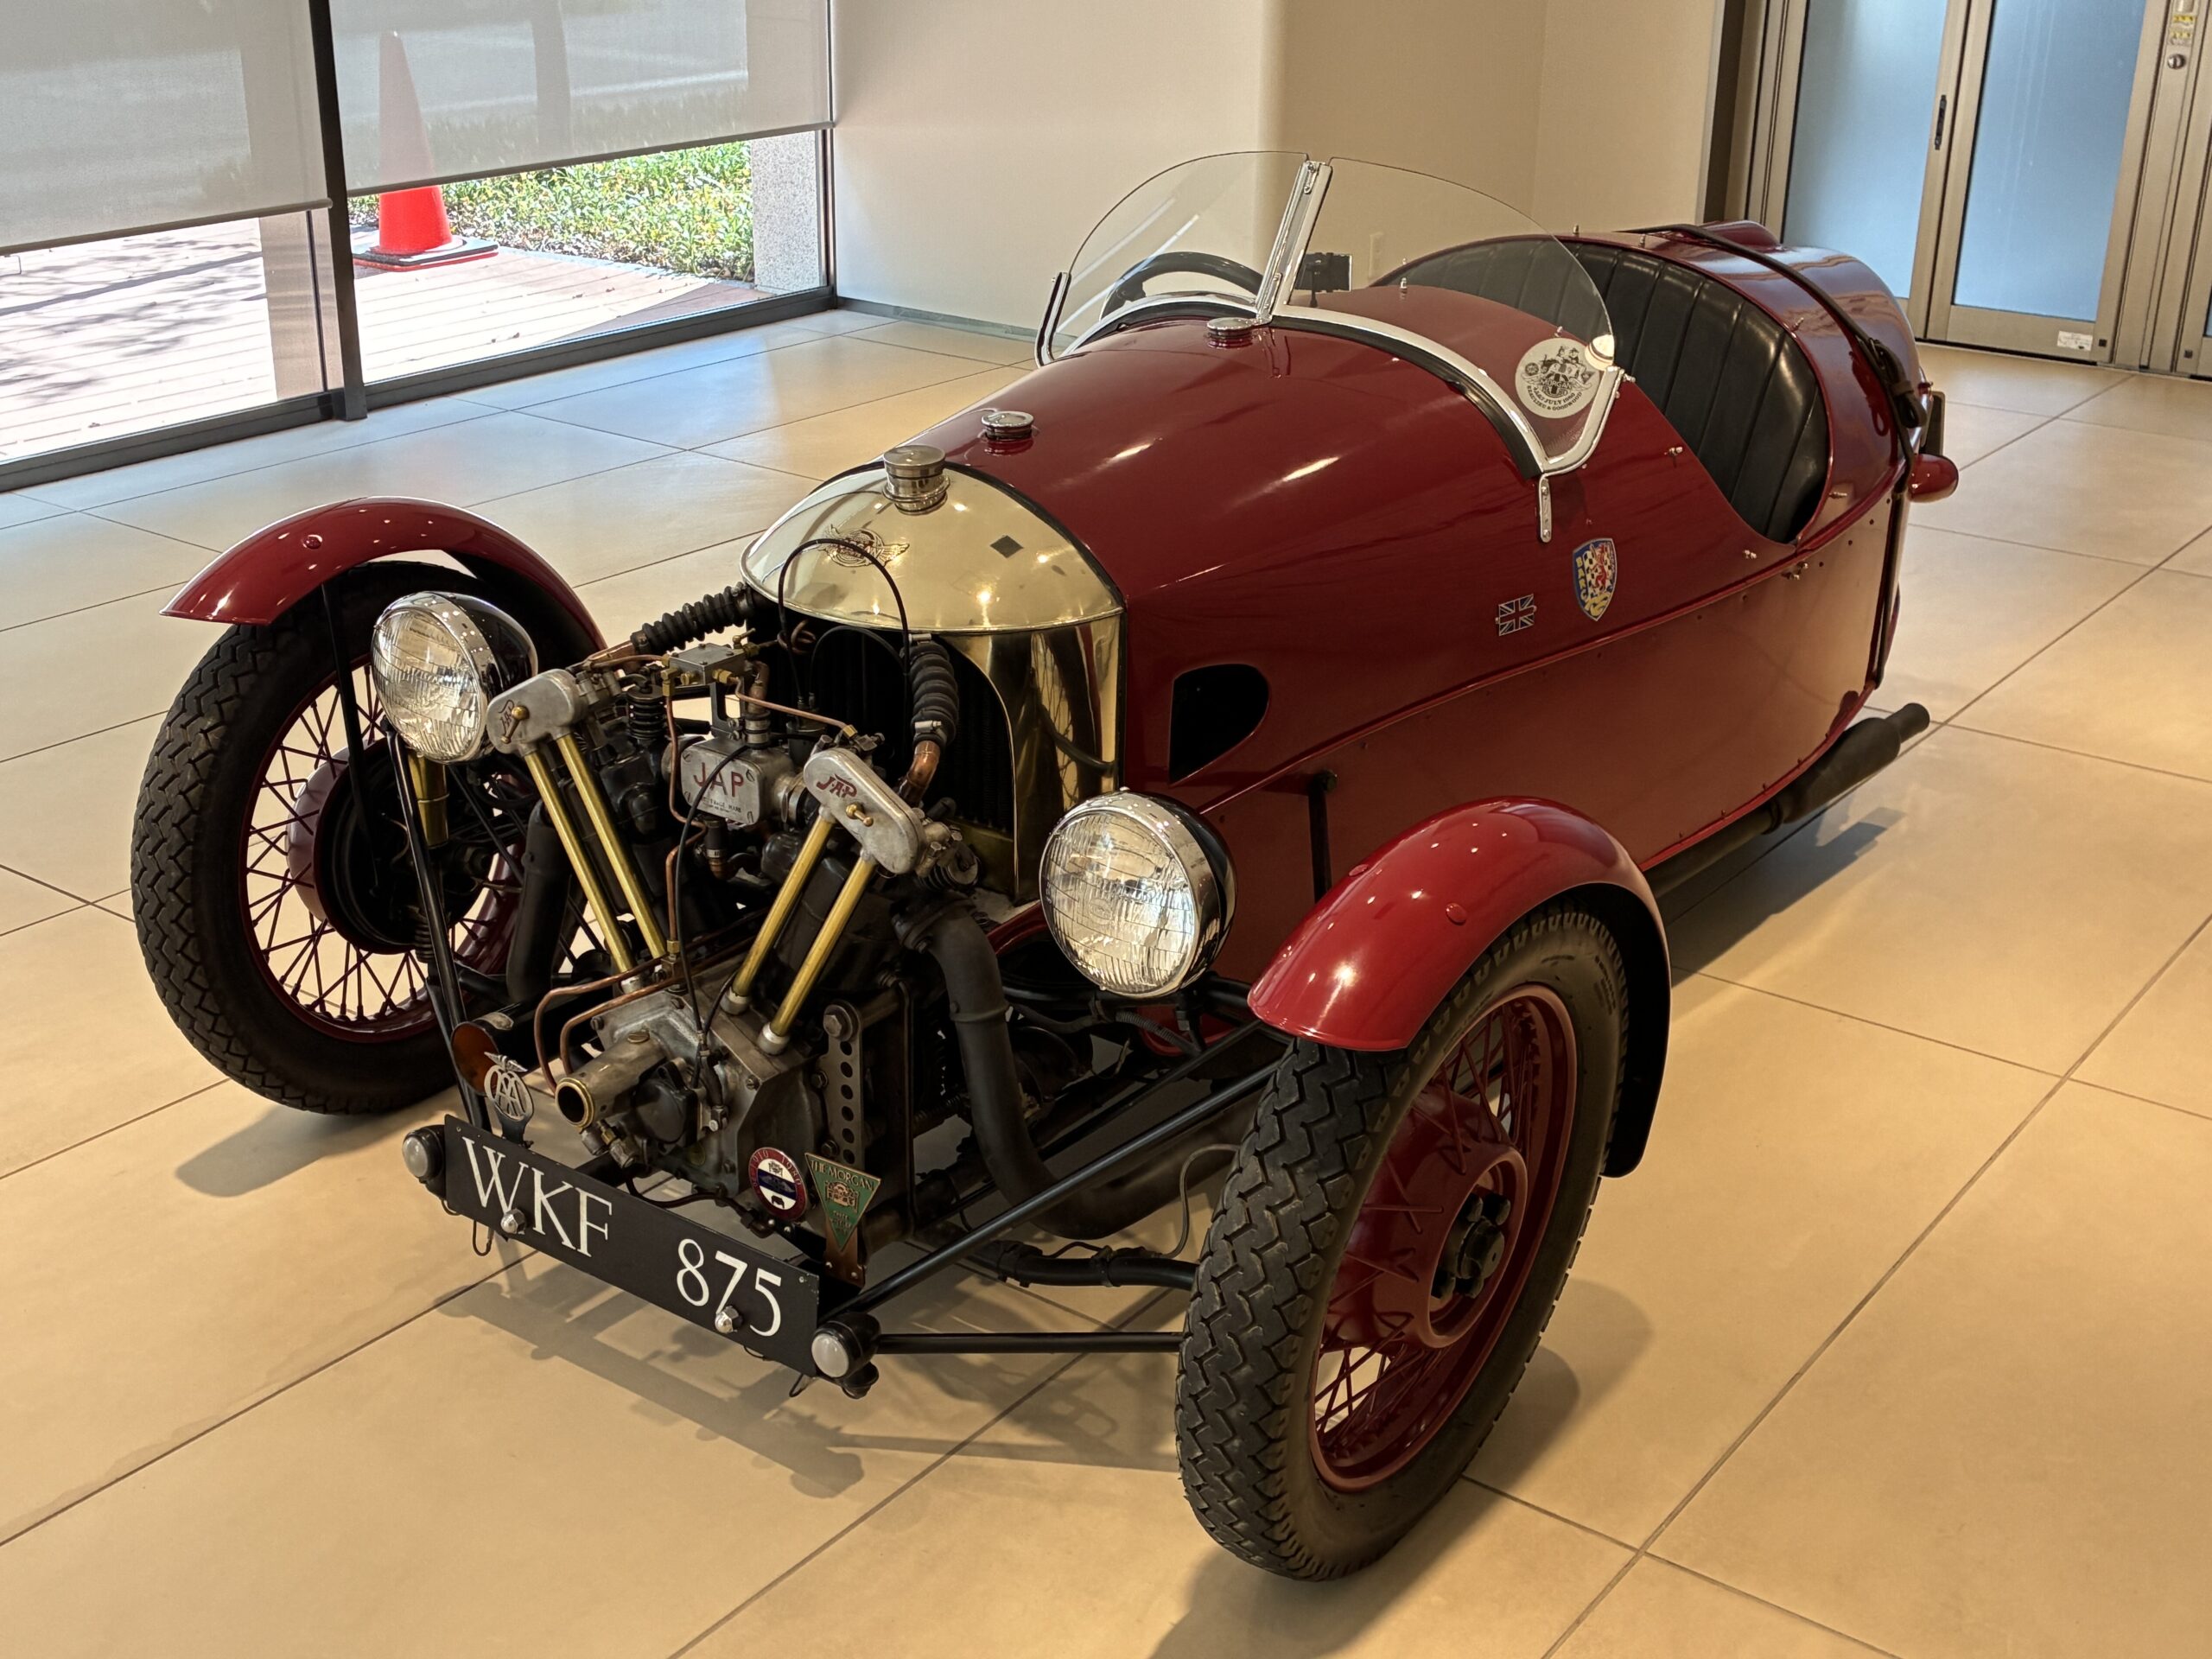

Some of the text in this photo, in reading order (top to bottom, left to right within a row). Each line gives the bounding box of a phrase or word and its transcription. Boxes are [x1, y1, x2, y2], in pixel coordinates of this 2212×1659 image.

[1541, 378, 1573, 390] MORGAN
[1552, 391, 1582, 410] GOODWOOD
[829, 1166, 875, 1192] MORGAN
[462, 1136, 782, 1338] WKF 875
